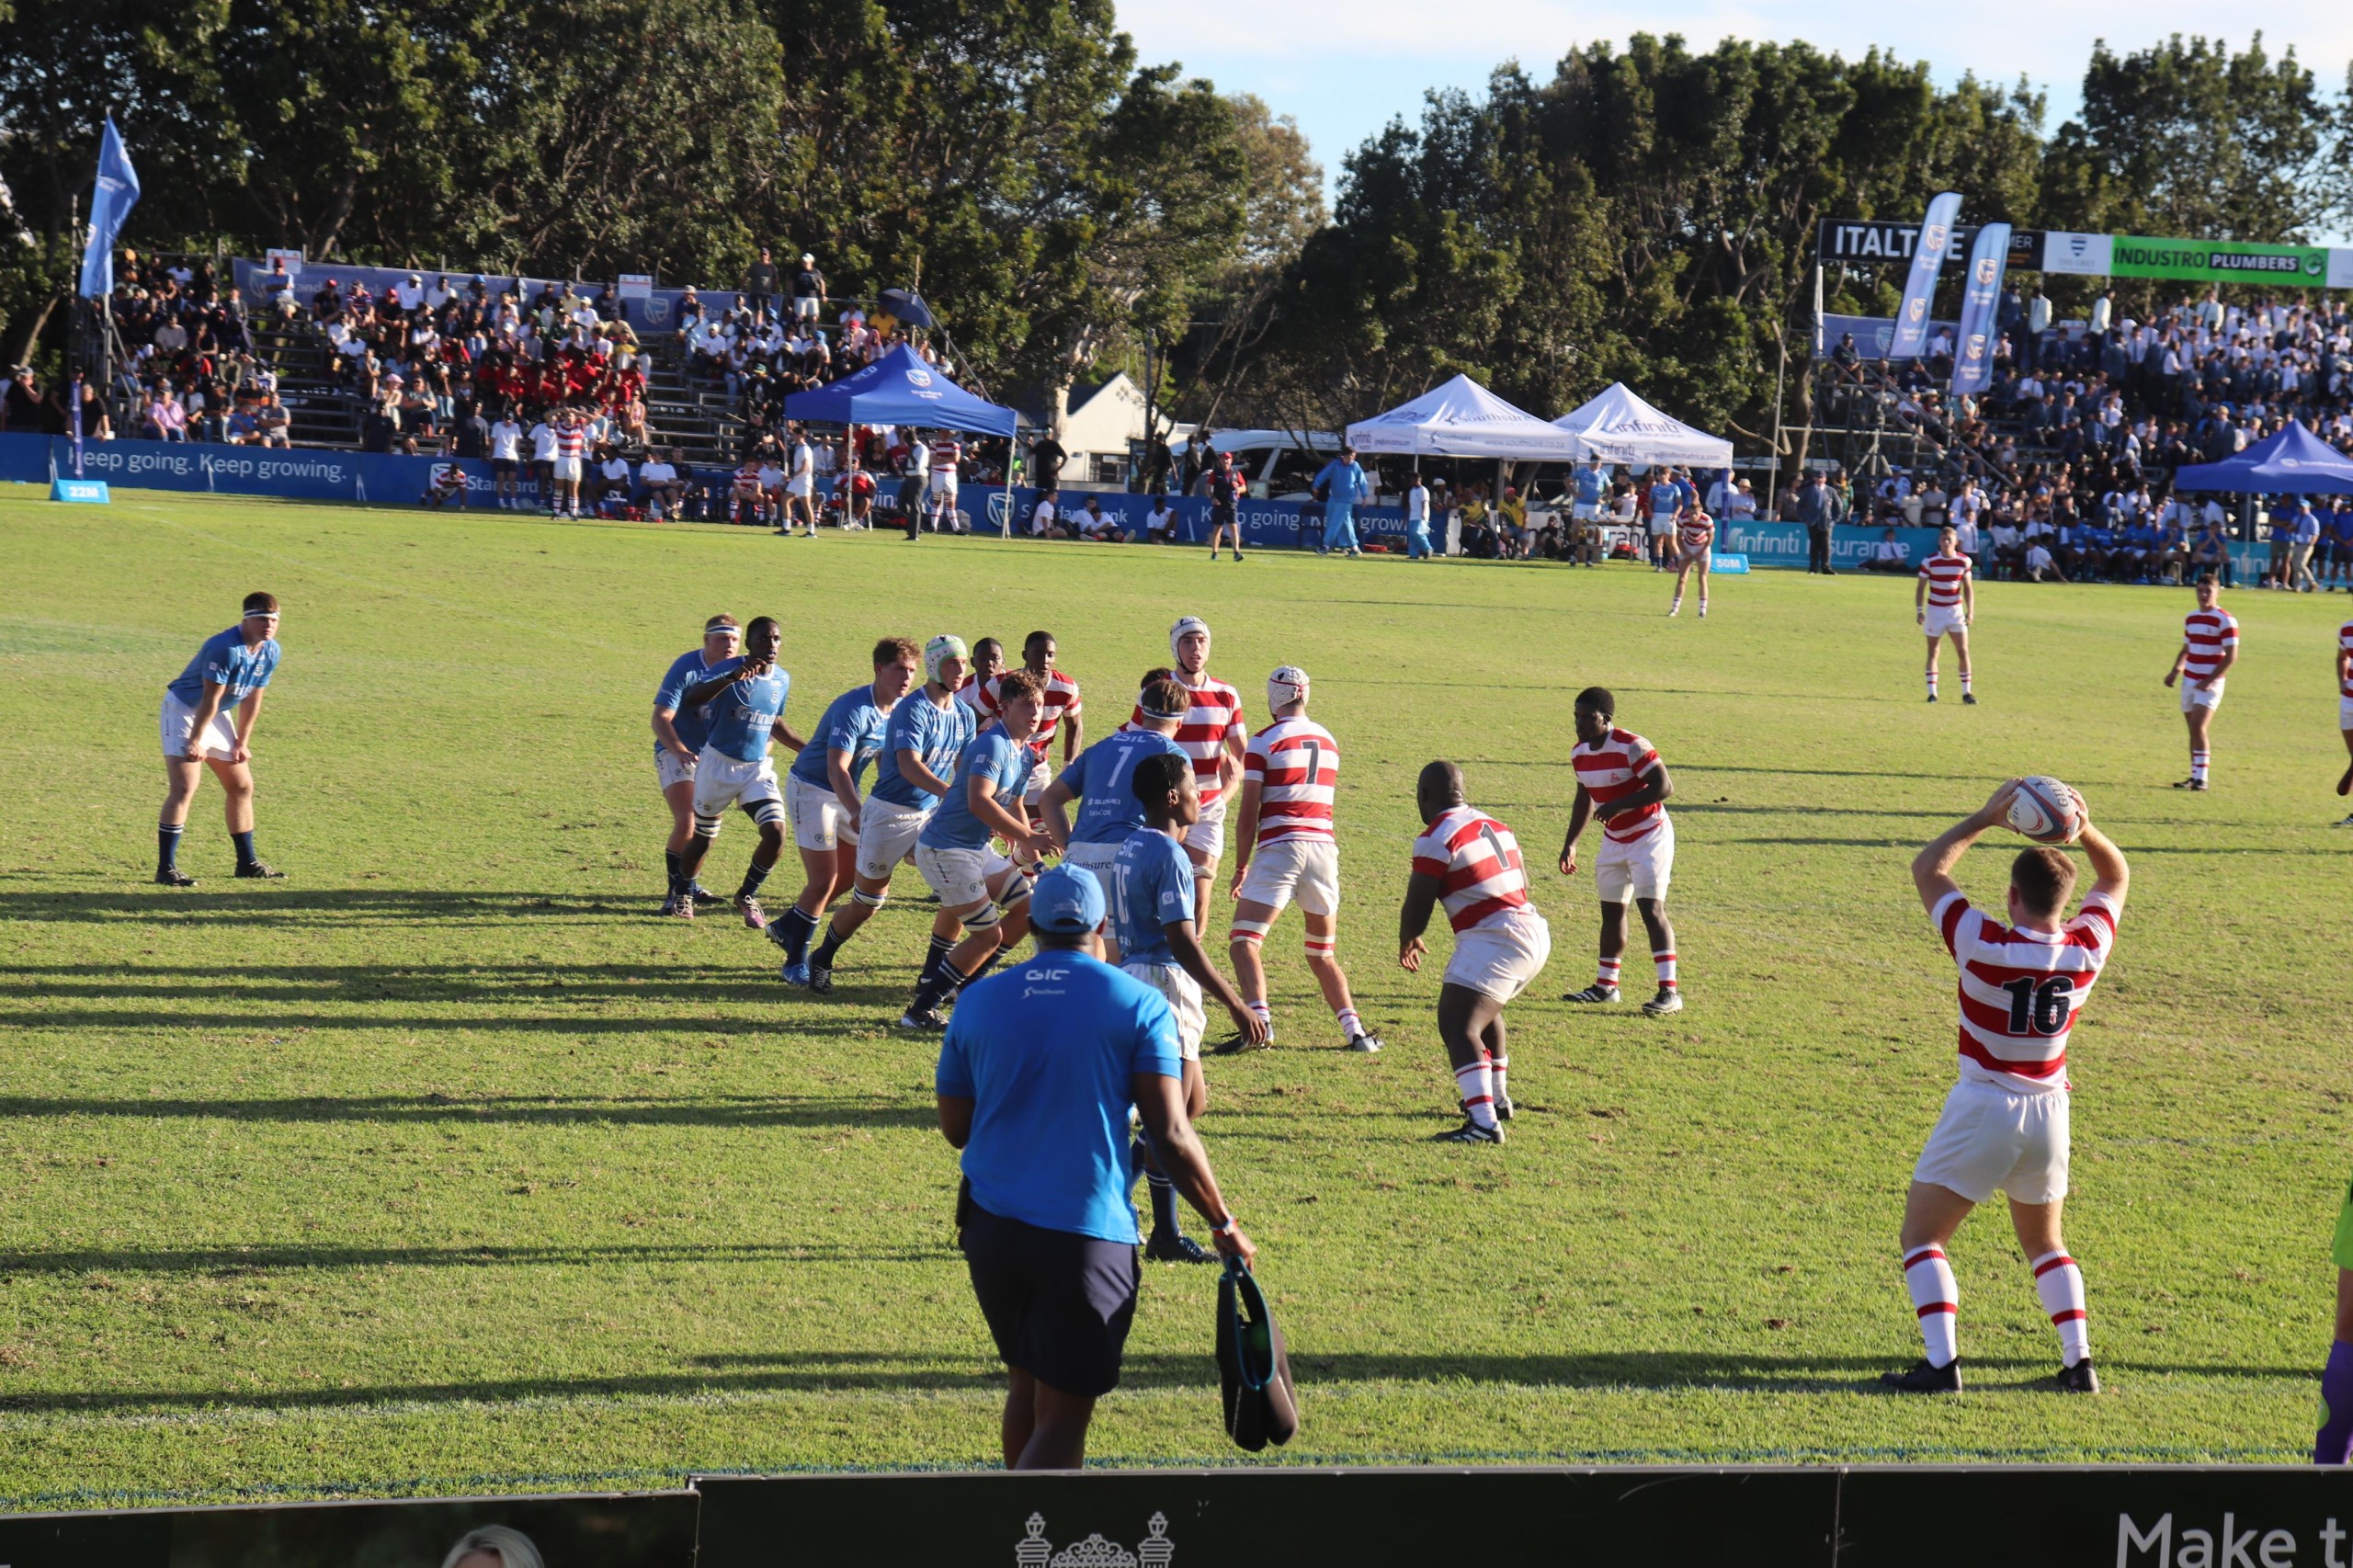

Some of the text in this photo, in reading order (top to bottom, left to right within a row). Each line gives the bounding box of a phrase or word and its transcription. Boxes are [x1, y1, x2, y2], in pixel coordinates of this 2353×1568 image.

[1836, 225, 1965, 260] ITALTE
[2114, 247, 2297, 271] INDUSTRO PLUMBERS
[128, 451, 194, 473] going.
[199, 453, 253, 478] Keep
[258, 458, 347, 483] growing.
[69, 485, 99, 498] 22M
[1250, 508, 1305, 531] going.
[1738, 529, 1801, 552] infiniti
[1716, 558, 1741, 569] 50M
[1300, 740, 1321, 784] 7
[1479, 822, 1510, 870] 1
[1026, 968, 1071, 981] GIC
[2002, 975, 2075, 1035] 16
[2117, 1512, 2353, 1568] Make t
